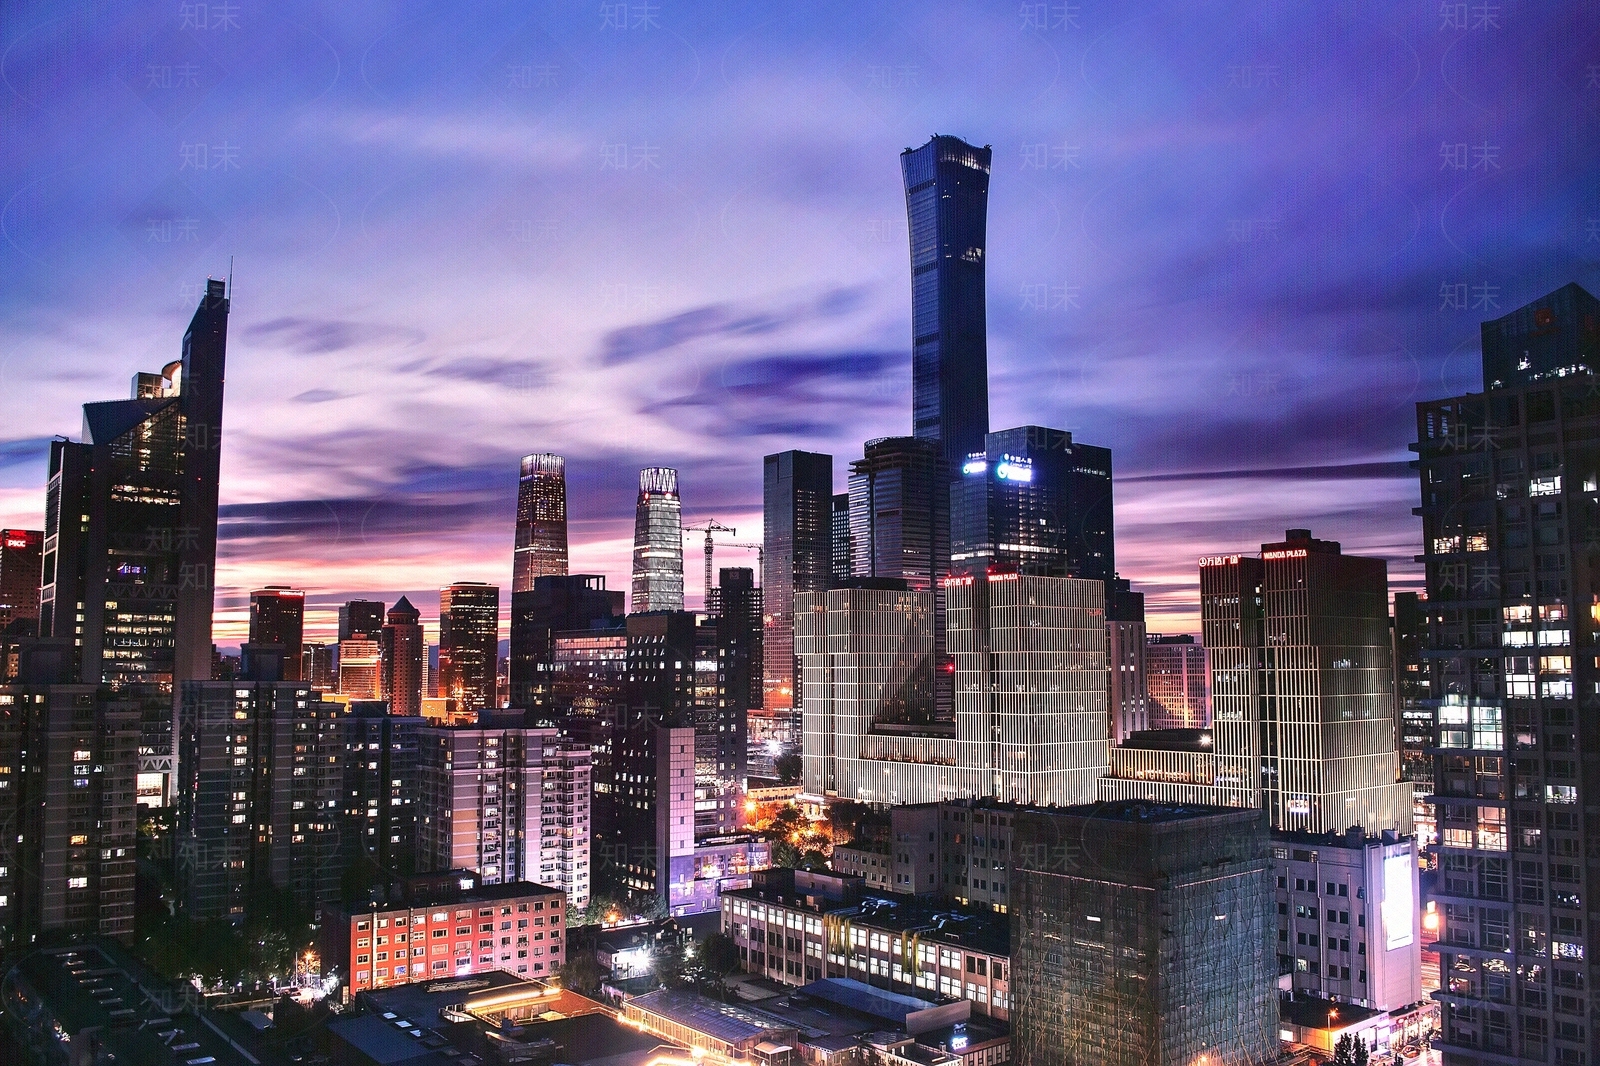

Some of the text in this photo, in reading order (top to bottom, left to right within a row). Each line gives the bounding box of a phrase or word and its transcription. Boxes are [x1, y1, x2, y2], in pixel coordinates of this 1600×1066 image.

[1263, 549, 1307, 560] WANDA PLAZA
[1207, 555, 1238, 566] 万达广场
